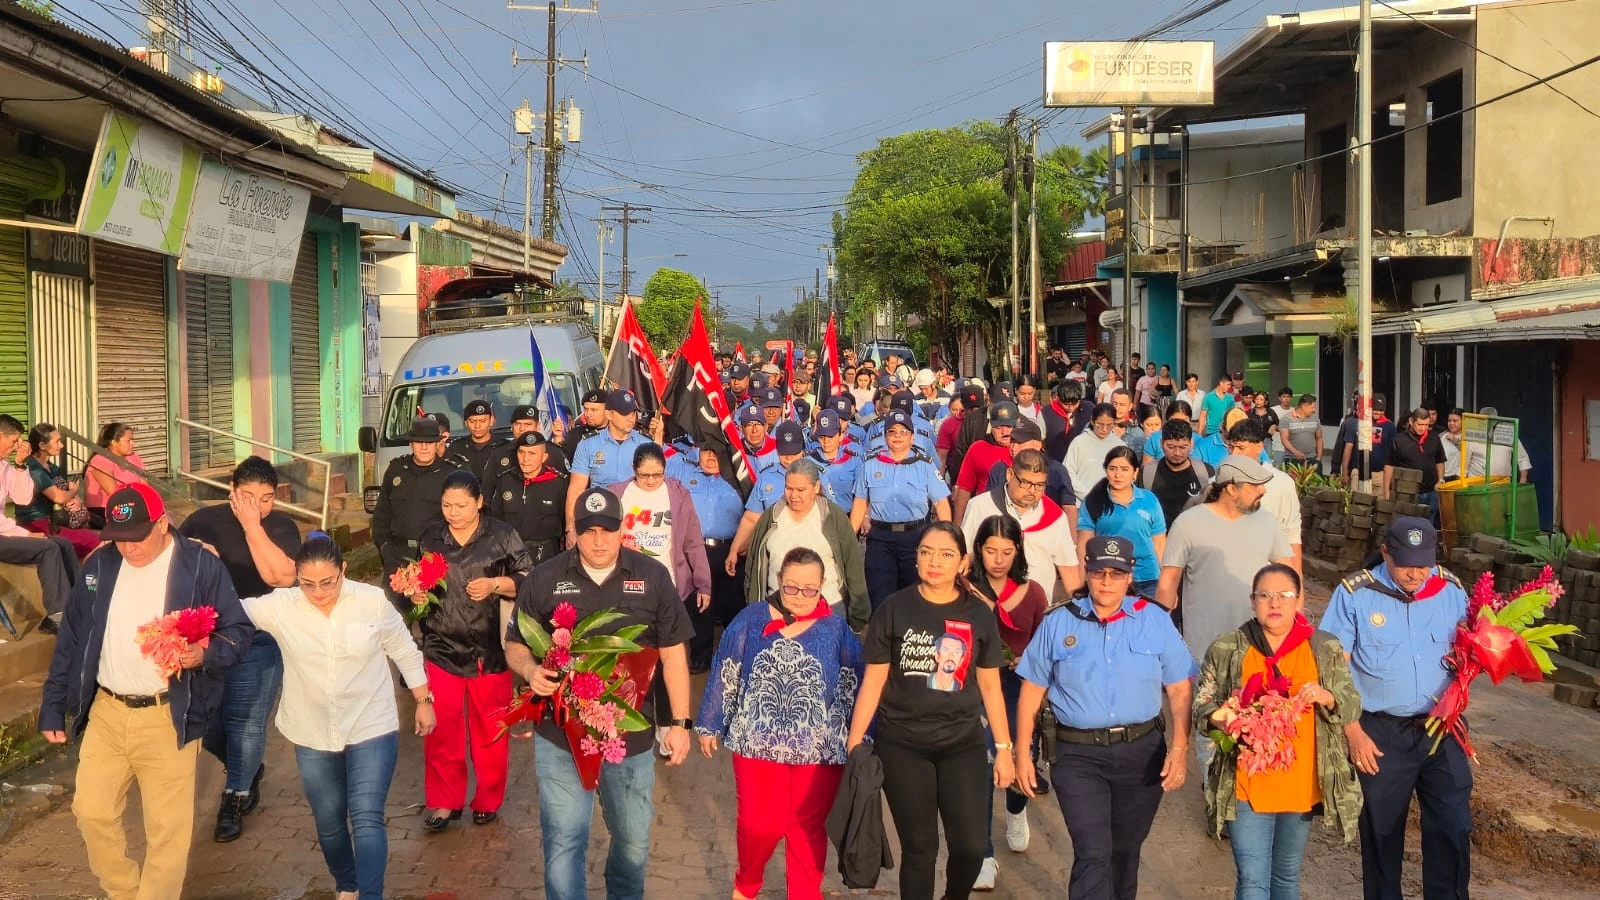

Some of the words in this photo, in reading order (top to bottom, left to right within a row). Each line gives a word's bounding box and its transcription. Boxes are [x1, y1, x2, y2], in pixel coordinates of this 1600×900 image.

[1094, 61, 1193, 76] FUNDESER
[125, 158, 139, 189] MI
[219, 166, 242, 208] La
[242, 174, 294, 220] Fuente
[904, 628, 934, 645] Carlos
[900, 641, 937, 657] Fonseca
[900, 655, 936, 672] Amador
